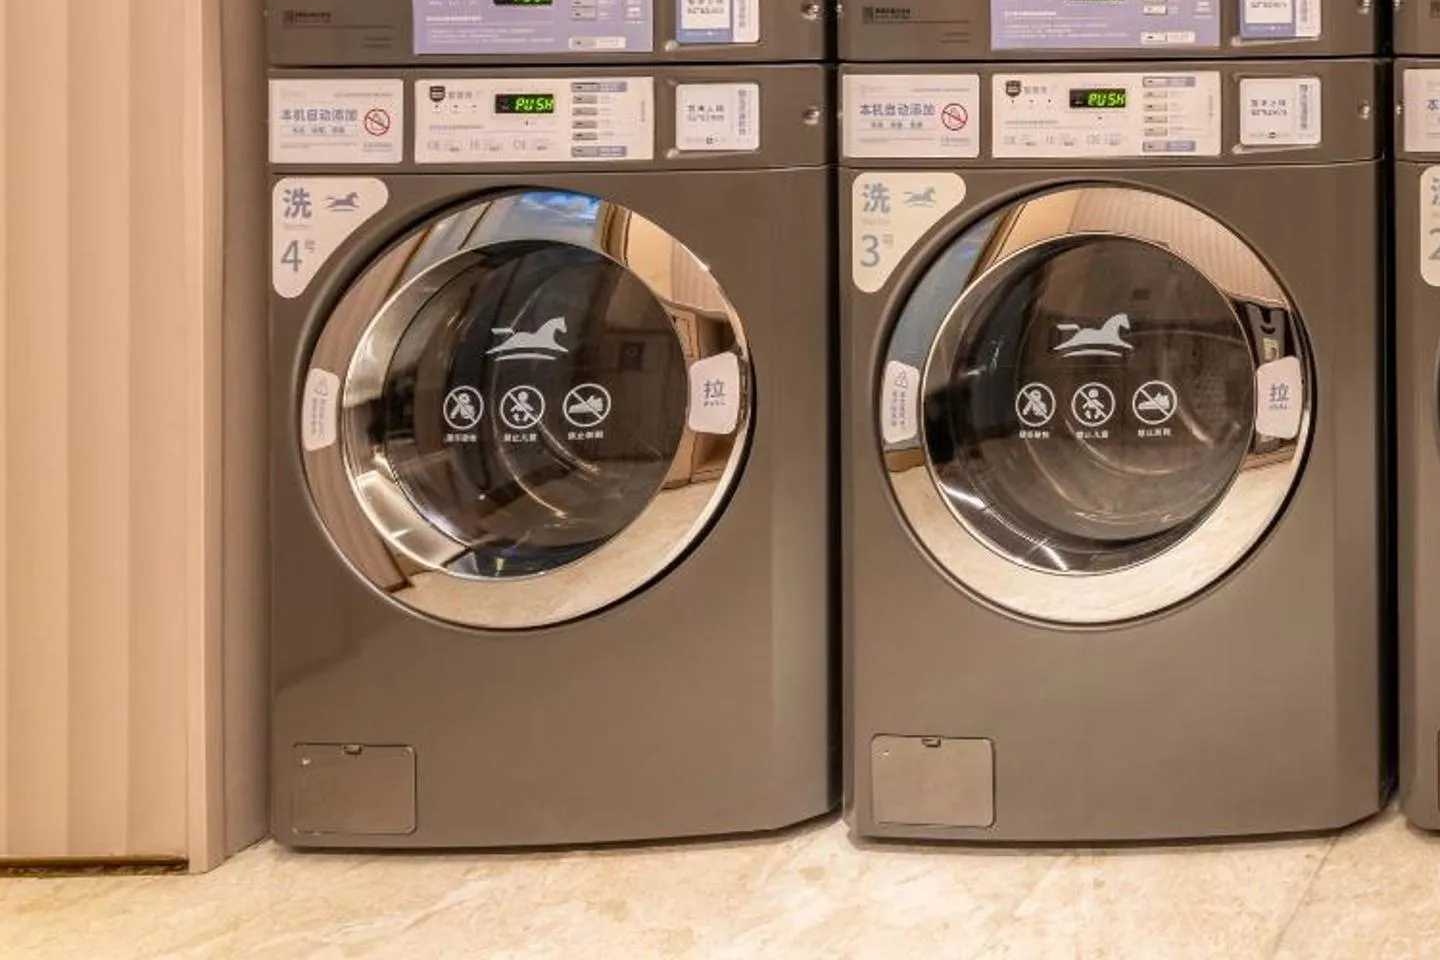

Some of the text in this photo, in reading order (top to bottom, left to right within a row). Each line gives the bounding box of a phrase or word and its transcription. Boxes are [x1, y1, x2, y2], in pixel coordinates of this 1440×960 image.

[515, 98, 554, 111] PUSH
[1089, 93, 1126, 106] PUSH
[282, 188, 312, 218] 洗
[862, 183, 892, 214] 洗
[703, 379, 726, 399] 拉
[1268, 382, 1290, 402] 拉
